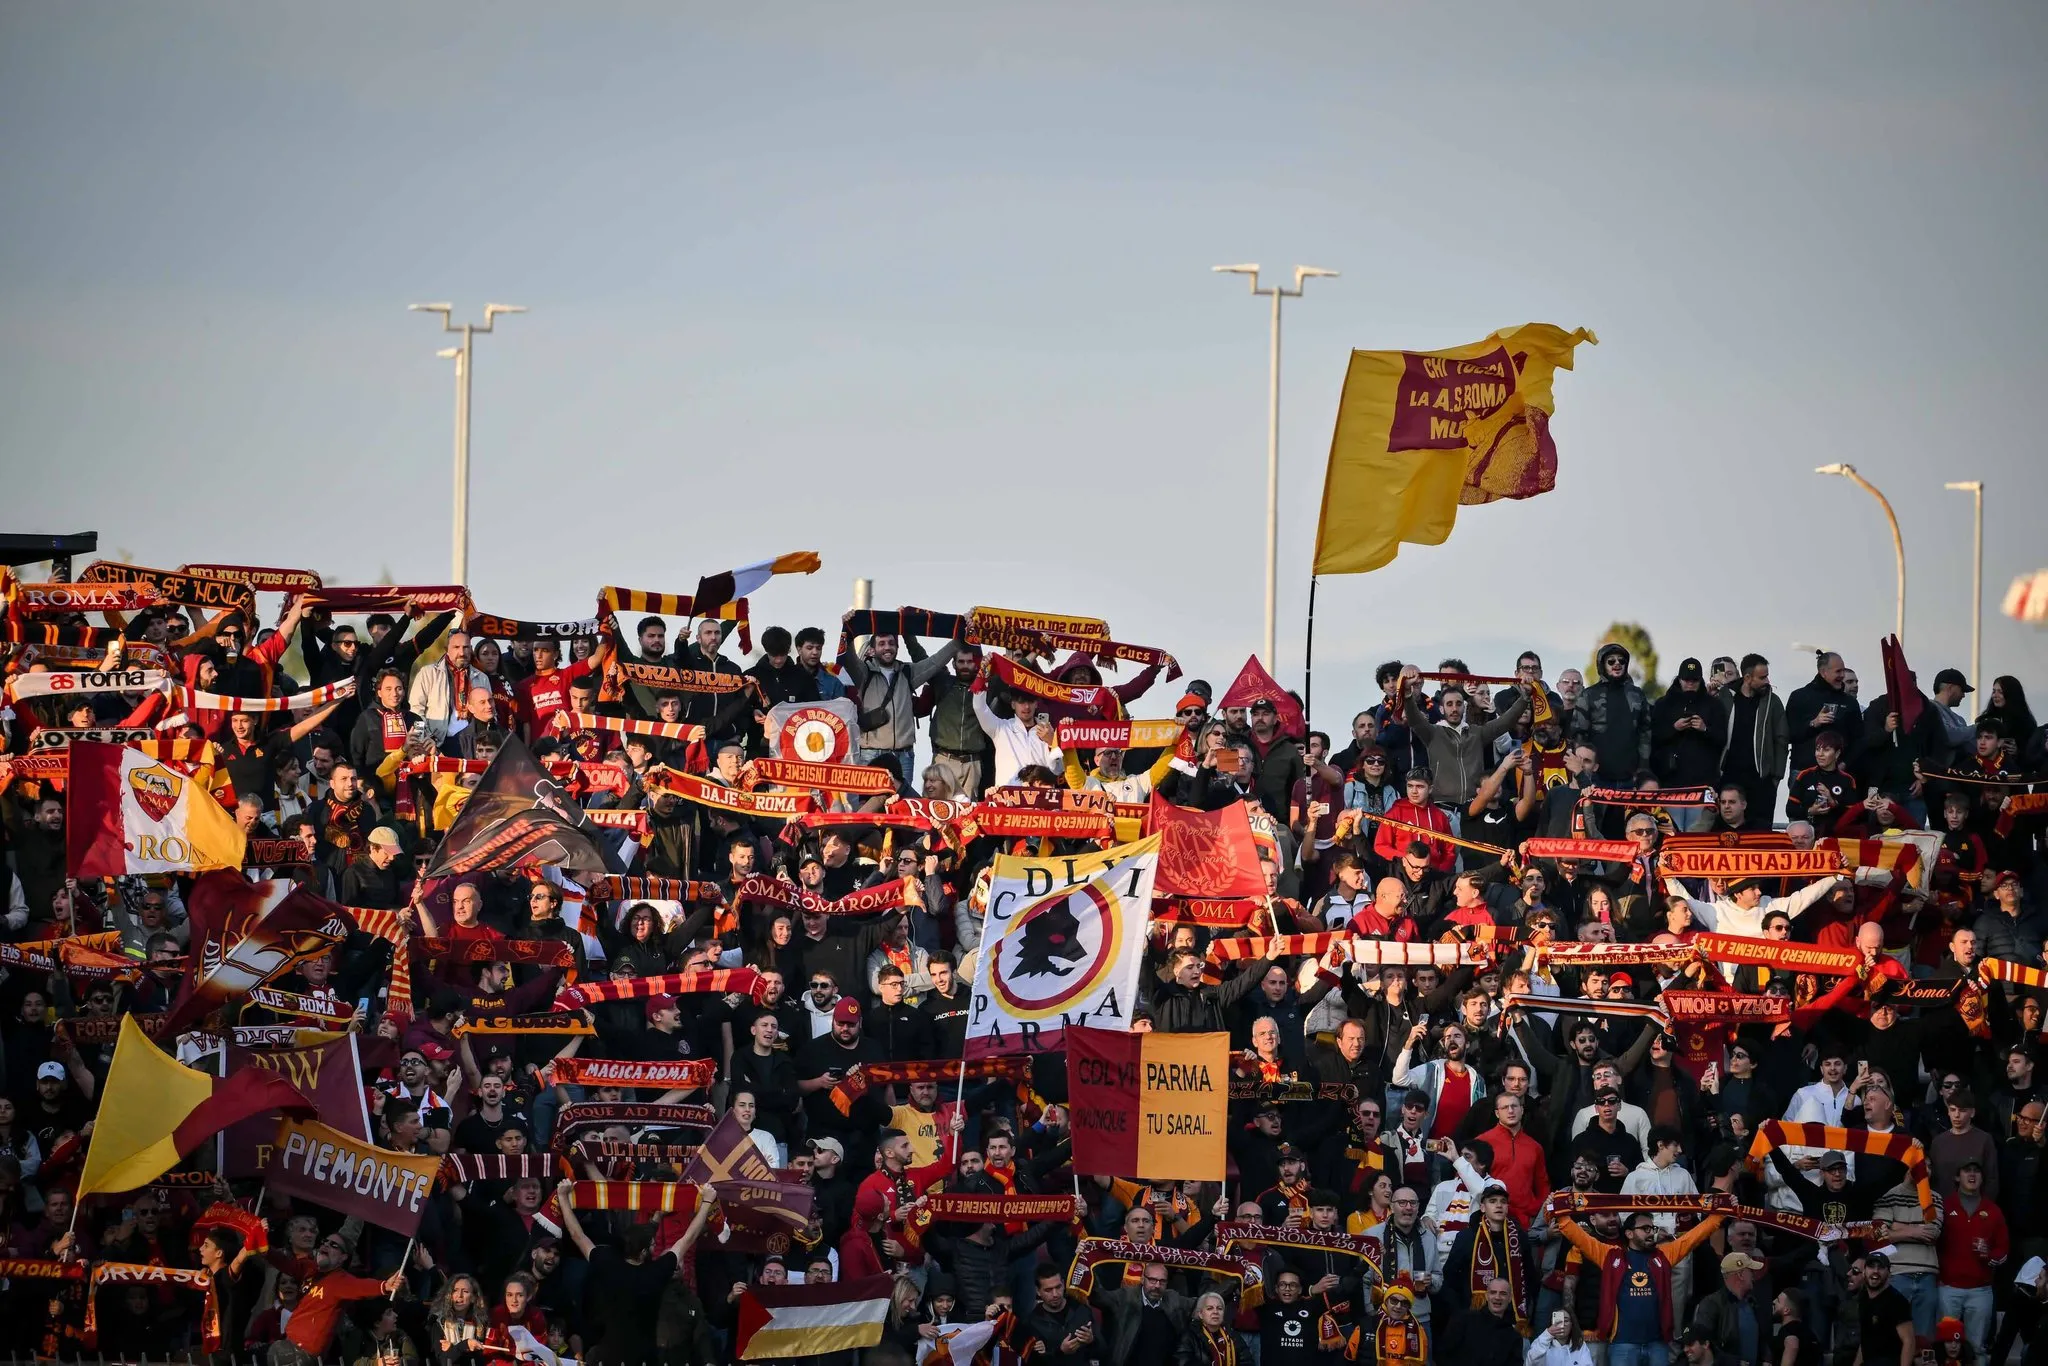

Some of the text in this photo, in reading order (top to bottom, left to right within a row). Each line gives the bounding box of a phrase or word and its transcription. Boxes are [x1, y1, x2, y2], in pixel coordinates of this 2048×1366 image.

[1423, 358, 1448, 379] CHI
[1410, 390, 1429, 407] LA
[94, 565, 127, 583] CHI
[162, 577, 186, 599] SE
[252, 572, 284, 585] SOLO
[27, 589, 121, 606] ROMA
[1053, 635, 1102, 652] ecchio
[50, 671, 145, 690] as roma
[624, 663, 680, 683] FORZA
[694, 671, 742, 687] ROMA
[1012, 667, 1073, 702] ROMA
[807, 709, 845, 734] ROMA
[1060, 727, 1129, 743] OVUNQUE
[1133, 728, 1152, 740] TU
[759, 760, 773, 774] TE
[775, 764, 781, 778] A
[785, 763, 827, 783] INSIEME
[701, 784, 797, 812] DAJE ROMA
[977, 812, 990, 827] TE
[994, 813, 1001, 827] A
[1004, 814, 1050, 830] INSIEME
[1577, 843, 1598, 853] TU
[1177, 901, 1235, 918] ROMA
[1717, 940, 1725, 951] A
[1728, 940, 1777, 960] INSIEME
[1781, 948, 1856, 968] CAMMINERÒ
[1892, 978, 1963, 999] Roma!
[299, 999, 336, 1015] ROMA
[1669, 996, 1783, 1015] FORZA ROMA
[934, 1012, 950, 1021] JACK
[972, 987, 1122, 1050] PARMA
[76, 1021, 118, 1037] FORZ
[585, 1063, 690, 1081] MAGICA ROMA
[1078, 1057, 1213, 1092] CDLVI PARMA
[564, 1106, 709, 1122] USQUE AD FINEM
[1075, 1109, 1212, 1135] OVUNQUE TU SARAI...
[282, 1131, 428, 1214] PIEMONTE
[931, 1199, 1070, 1217] CAMMINERÒ INSIEME A TE
[1632, 1195, 1693, 1207] ROMA
[1332, 1238, 1381, 1265] 456 KM
[1162, 1253, 1210, 1268] ROMA
